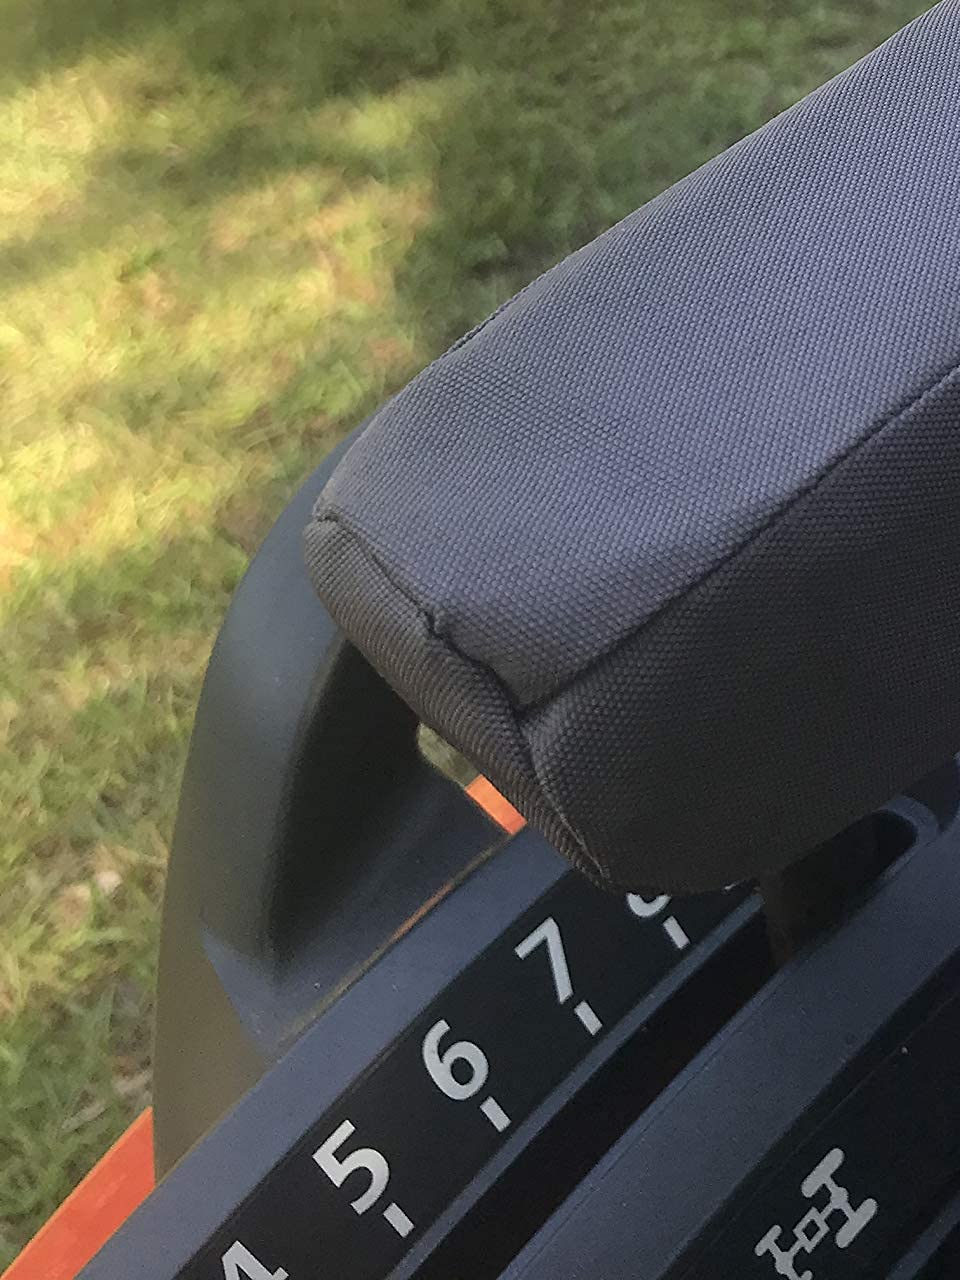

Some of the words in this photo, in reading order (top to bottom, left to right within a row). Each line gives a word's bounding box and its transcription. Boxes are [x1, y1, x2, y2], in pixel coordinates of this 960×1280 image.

[312, 1119, 391, 1215] 5
[422, 1019, 489, 1101] 6
[514, 917, 574, 1004] 7
